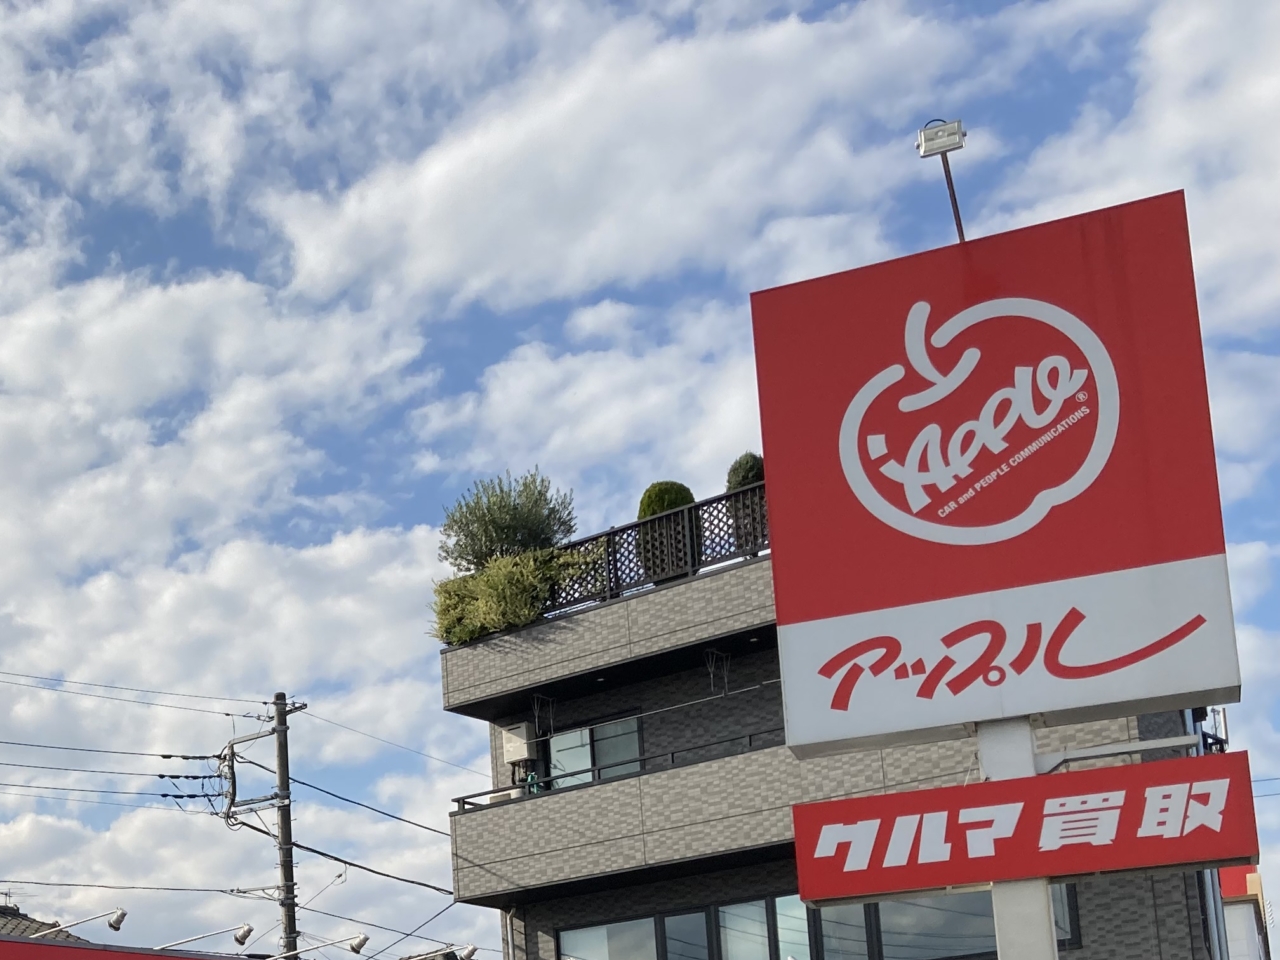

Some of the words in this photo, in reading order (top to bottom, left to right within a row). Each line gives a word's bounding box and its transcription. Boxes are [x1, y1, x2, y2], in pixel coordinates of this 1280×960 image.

[878, 355, 1088, 514] Apple
[937, 501, 958, 518] CAR
[958, 488, 975, 505] and
[974, 463, 1011, 492] PEOPLE
[1008, 405, 1091, 467] COMMUNICATIONS
[819, 607, 1207, 712] アップル
